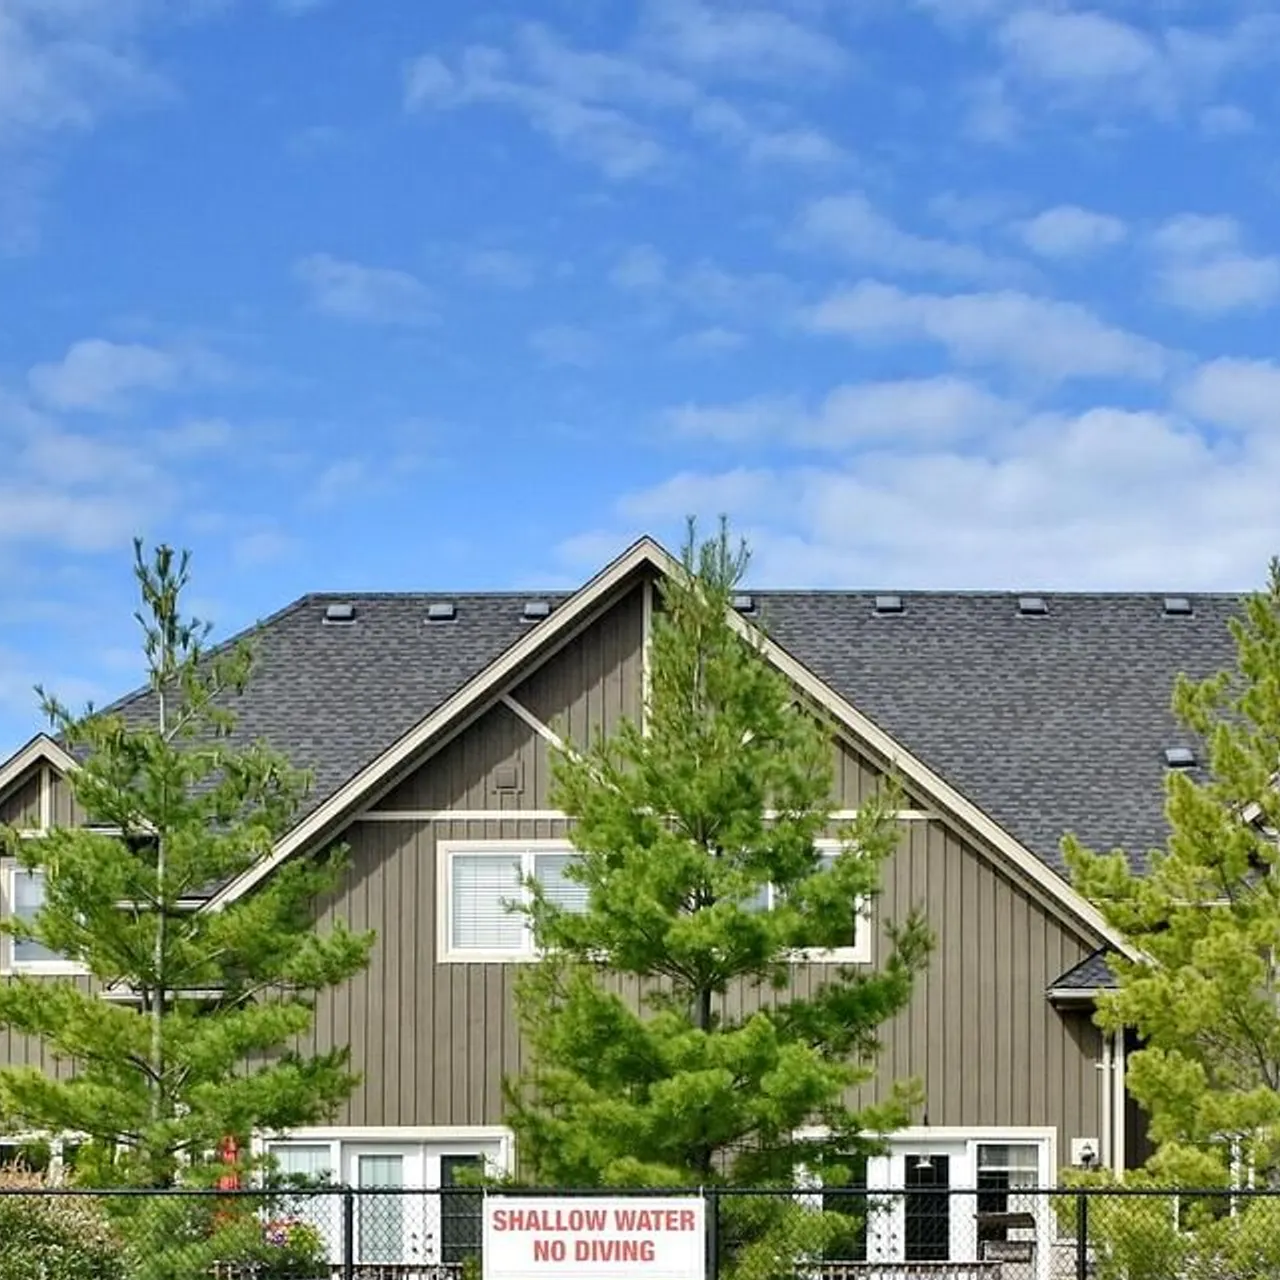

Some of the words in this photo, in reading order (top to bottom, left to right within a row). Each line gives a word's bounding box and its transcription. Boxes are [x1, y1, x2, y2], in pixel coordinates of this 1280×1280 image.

[492, 1209, 608, 1232] SHALLOW
[614, 1210, 696, 1232] WATER
[533, 1240, 566, 1262] NO
[574, 1240, 656, 1262] DIVING
